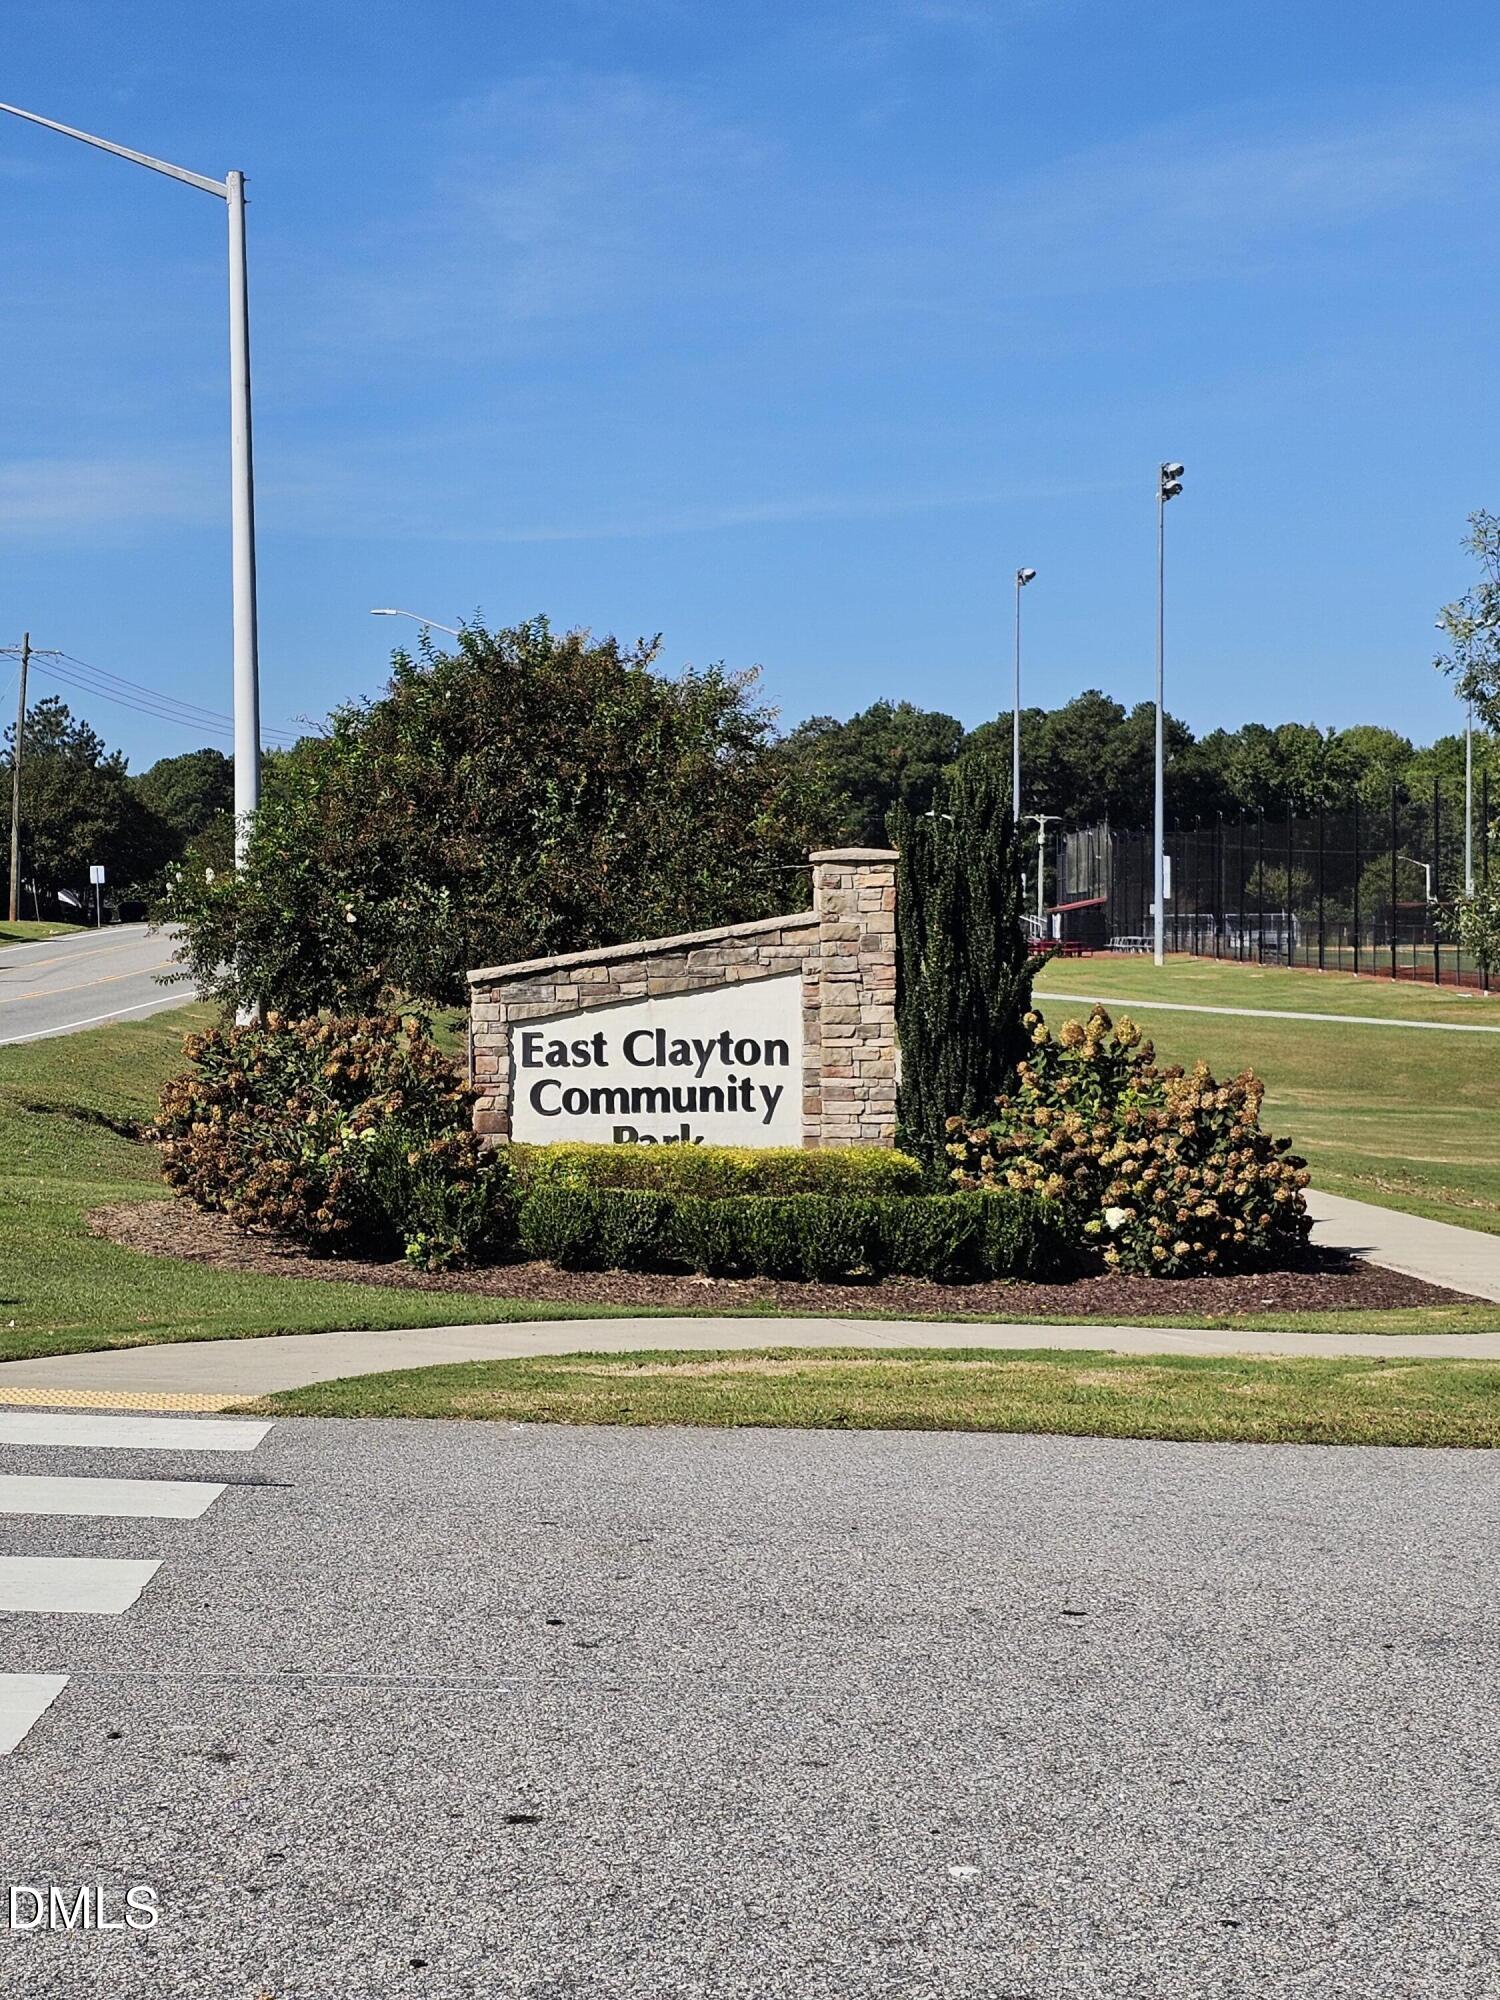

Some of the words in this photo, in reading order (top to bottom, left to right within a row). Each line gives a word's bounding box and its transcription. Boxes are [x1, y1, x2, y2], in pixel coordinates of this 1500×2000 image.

[521, 1031, 608, 1068] East
[622, 1028, 790, 1078] Clayton
[529, 1074, 783, 1124] Community
